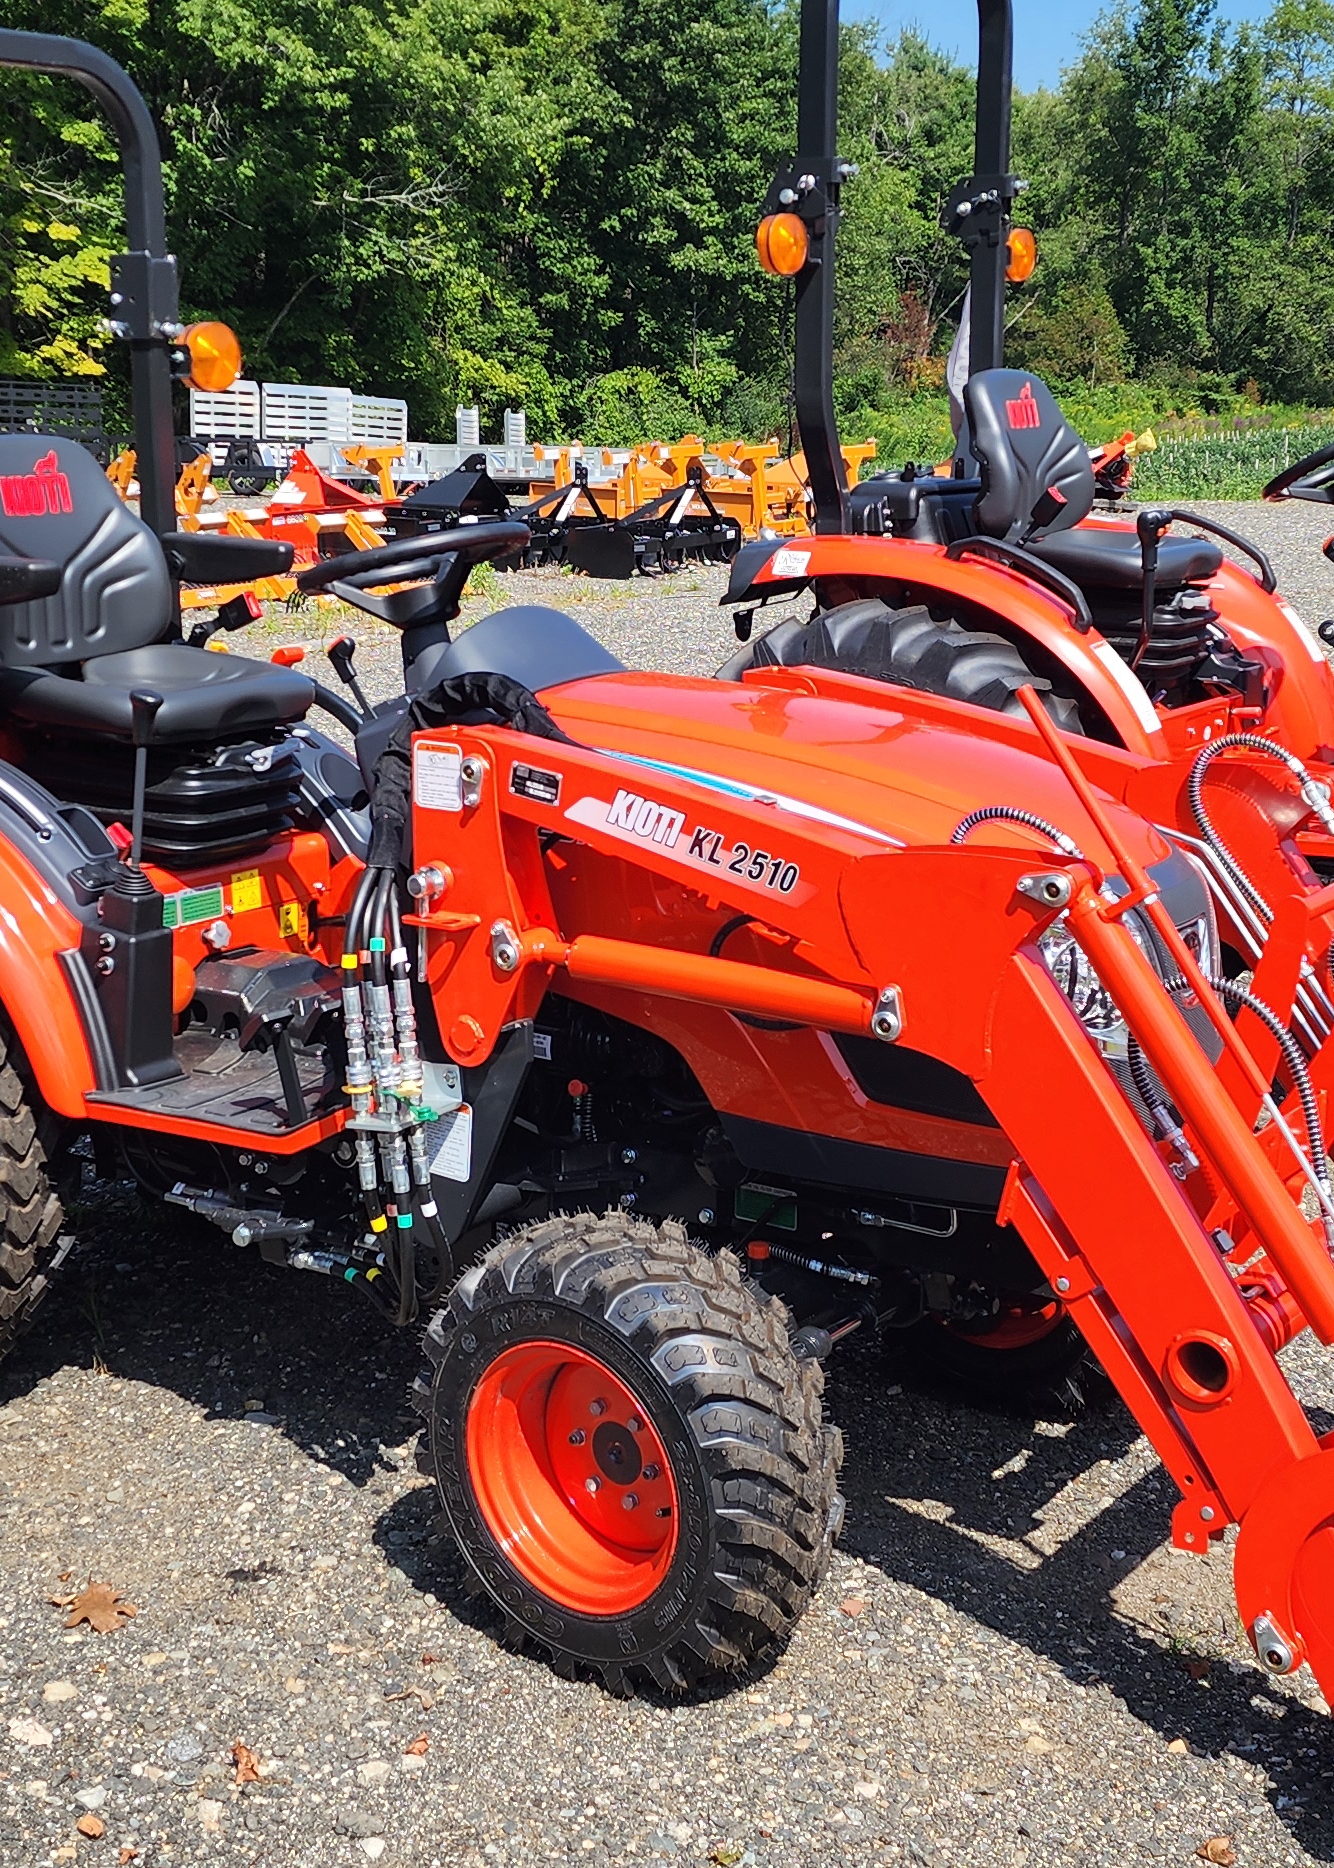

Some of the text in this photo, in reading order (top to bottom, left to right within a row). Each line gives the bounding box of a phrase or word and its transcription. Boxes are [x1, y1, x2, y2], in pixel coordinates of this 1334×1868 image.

[606, 789, 800, 894] KIOTI KL 2510
[436, 1412, 566, 1639] GOODYEAR
